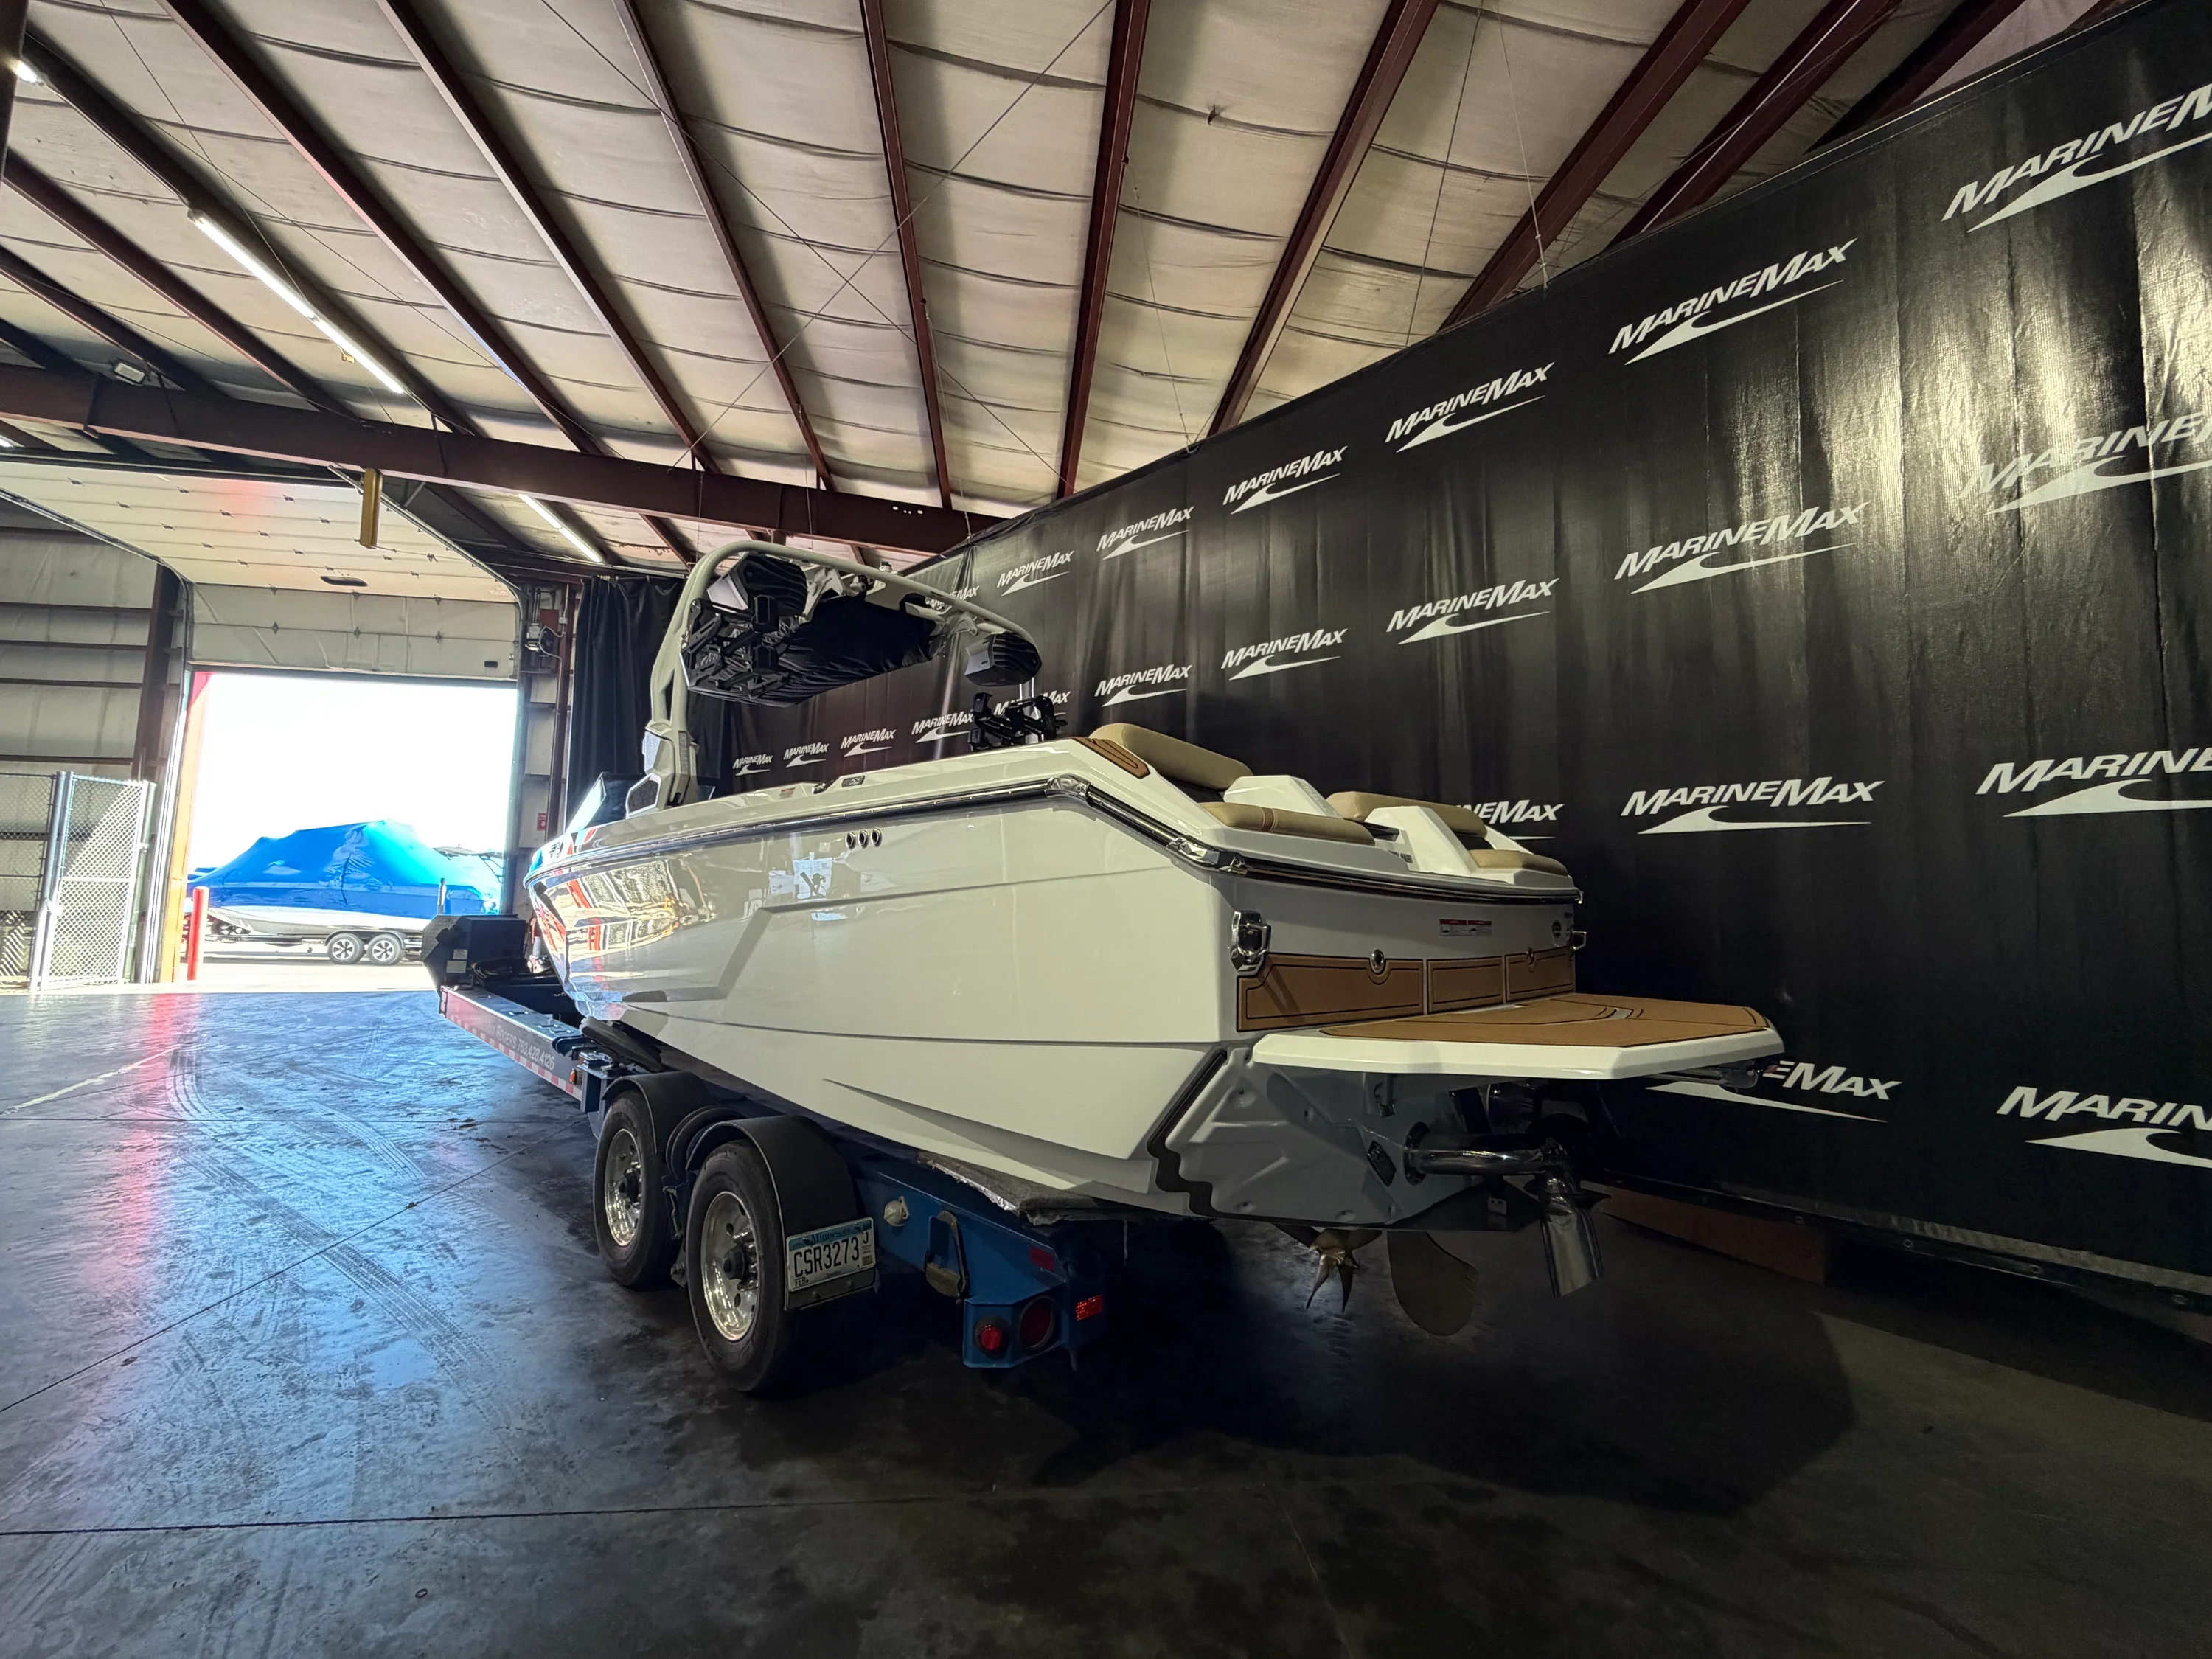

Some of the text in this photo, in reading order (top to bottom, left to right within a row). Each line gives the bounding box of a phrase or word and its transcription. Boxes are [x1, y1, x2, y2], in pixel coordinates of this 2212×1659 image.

[1608, 237, 1858, 355] MARINEMAX
[1385, 361, 1555, 443] MARINEMAX
[1222, 446, 1348, 506] MARINEMAX
[1957, 411, 2212, 499] MARINE
[1096, 506, 1194, 552] MARINEMAX
[1615, 501, 1871, 580] MARINEMAX
[997, 550, 1074, 588] MARINEMAX
[1386, 578, 1559, 633] MARINEMAX
[1221, 628, 1348, 669] MARINEMAX
[1095, 665, 1192, 697] MARINEMAX
[1621, 776, 1885, 817] MARINEMAX
[793, 1236, 860, 1277] CSR3273
